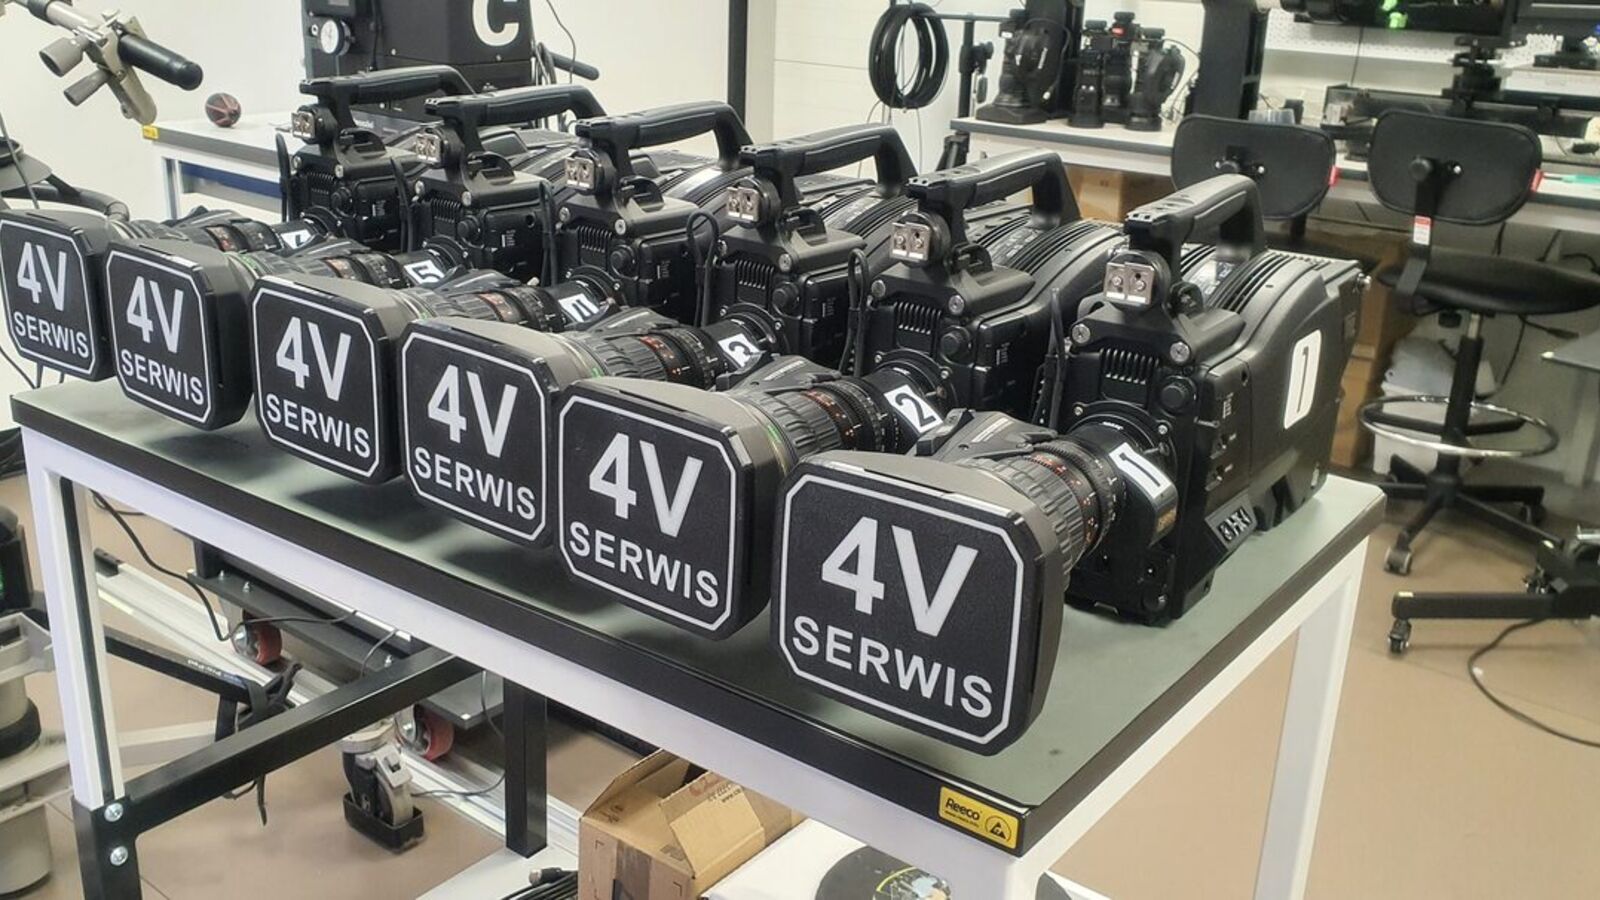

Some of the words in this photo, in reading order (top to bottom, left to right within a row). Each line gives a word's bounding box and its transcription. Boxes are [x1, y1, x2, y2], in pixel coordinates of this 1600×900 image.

[16, 241, 67, 312] 4V
[13, 311, 90, 359] SERWIS
[126, 276, 184, 354] 4V
[120, 348, 205, 406] SERWIS
[276, 317, 352, 402] 4V
[1296, 345, 1310, 414] 1
[267, 393, 371, 458] SERWIS
[427, 364, 518, 458] 4V
[895, 392, 937, 428] 2
[414, 446, 536, 520] SERWIS
[590, 432, 703, 538] 4V
[1118, 452, 1161, 488] 1
[569, 521, 719, 609] SERWIS
[822, 516, 978, 637] 4V
[793, 615, 993, 718] SERWIS
[945, 797, 980, 821] Reeco
